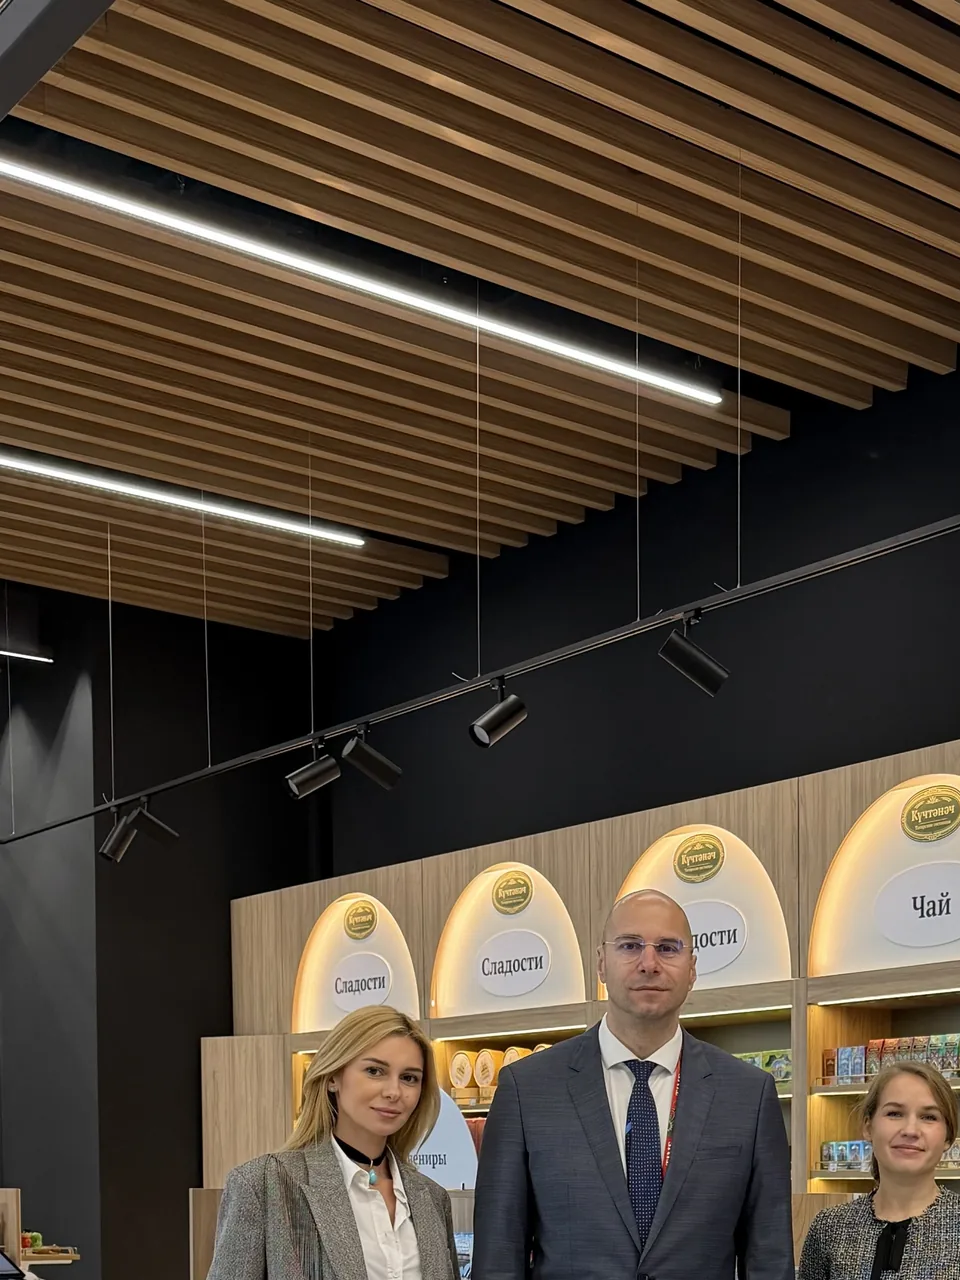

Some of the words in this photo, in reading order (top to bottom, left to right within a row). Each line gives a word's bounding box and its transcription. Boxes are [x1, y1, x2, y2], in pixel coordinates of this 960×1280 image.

[911, 891, 952, 919] Чай
[692, 928, 738, 952] дости
[481, 953, 544, 978] Сладости
[334, 974, 386, 995] Сладости
